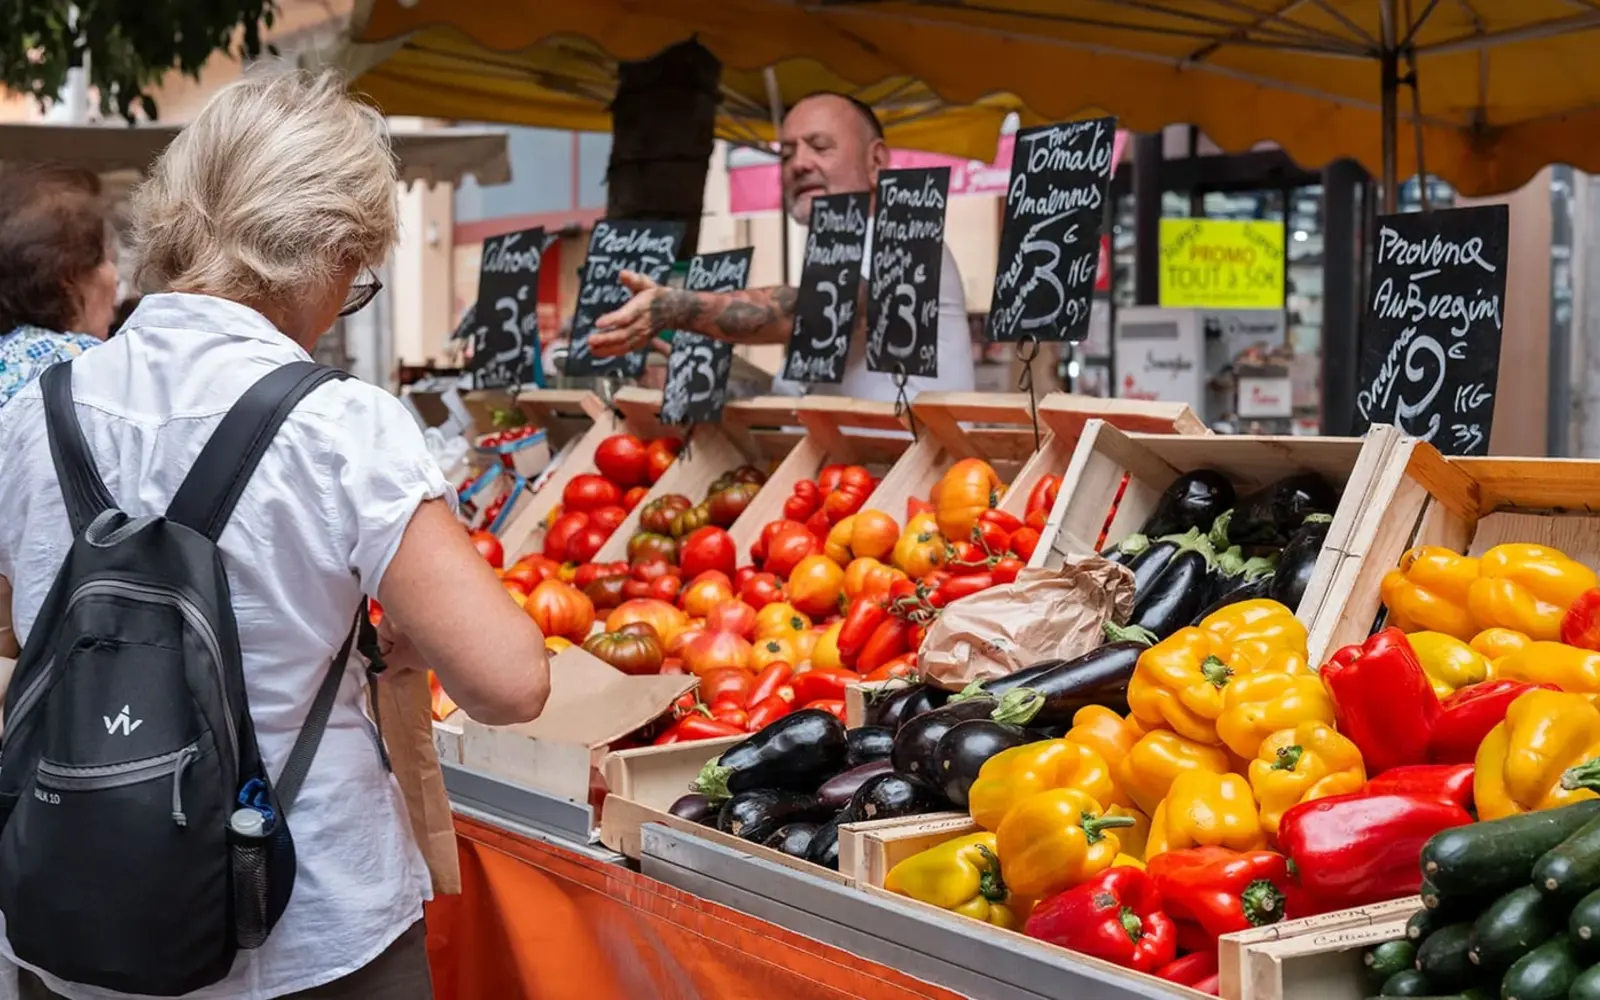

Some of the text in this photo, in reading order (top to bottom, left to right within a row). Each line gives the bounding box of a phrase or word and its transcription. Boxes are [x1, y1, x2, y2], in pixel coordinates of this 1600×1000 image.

[1019, 239, 1066, 330] 3
[1067, 254, 1094, 288] KG
[1168, 265, 1220, 289] TOUT
[1189, 245, 1257, 266] PROMO
[494, 295, 523, 364] 3
[810, 280, 839, 350] 3
[887, 283, 917, 358] 3
[690, 345, 715, 403] 3
[1393, 334, 1447, 442] 2
[1454, 383, 1492, 413] KG
